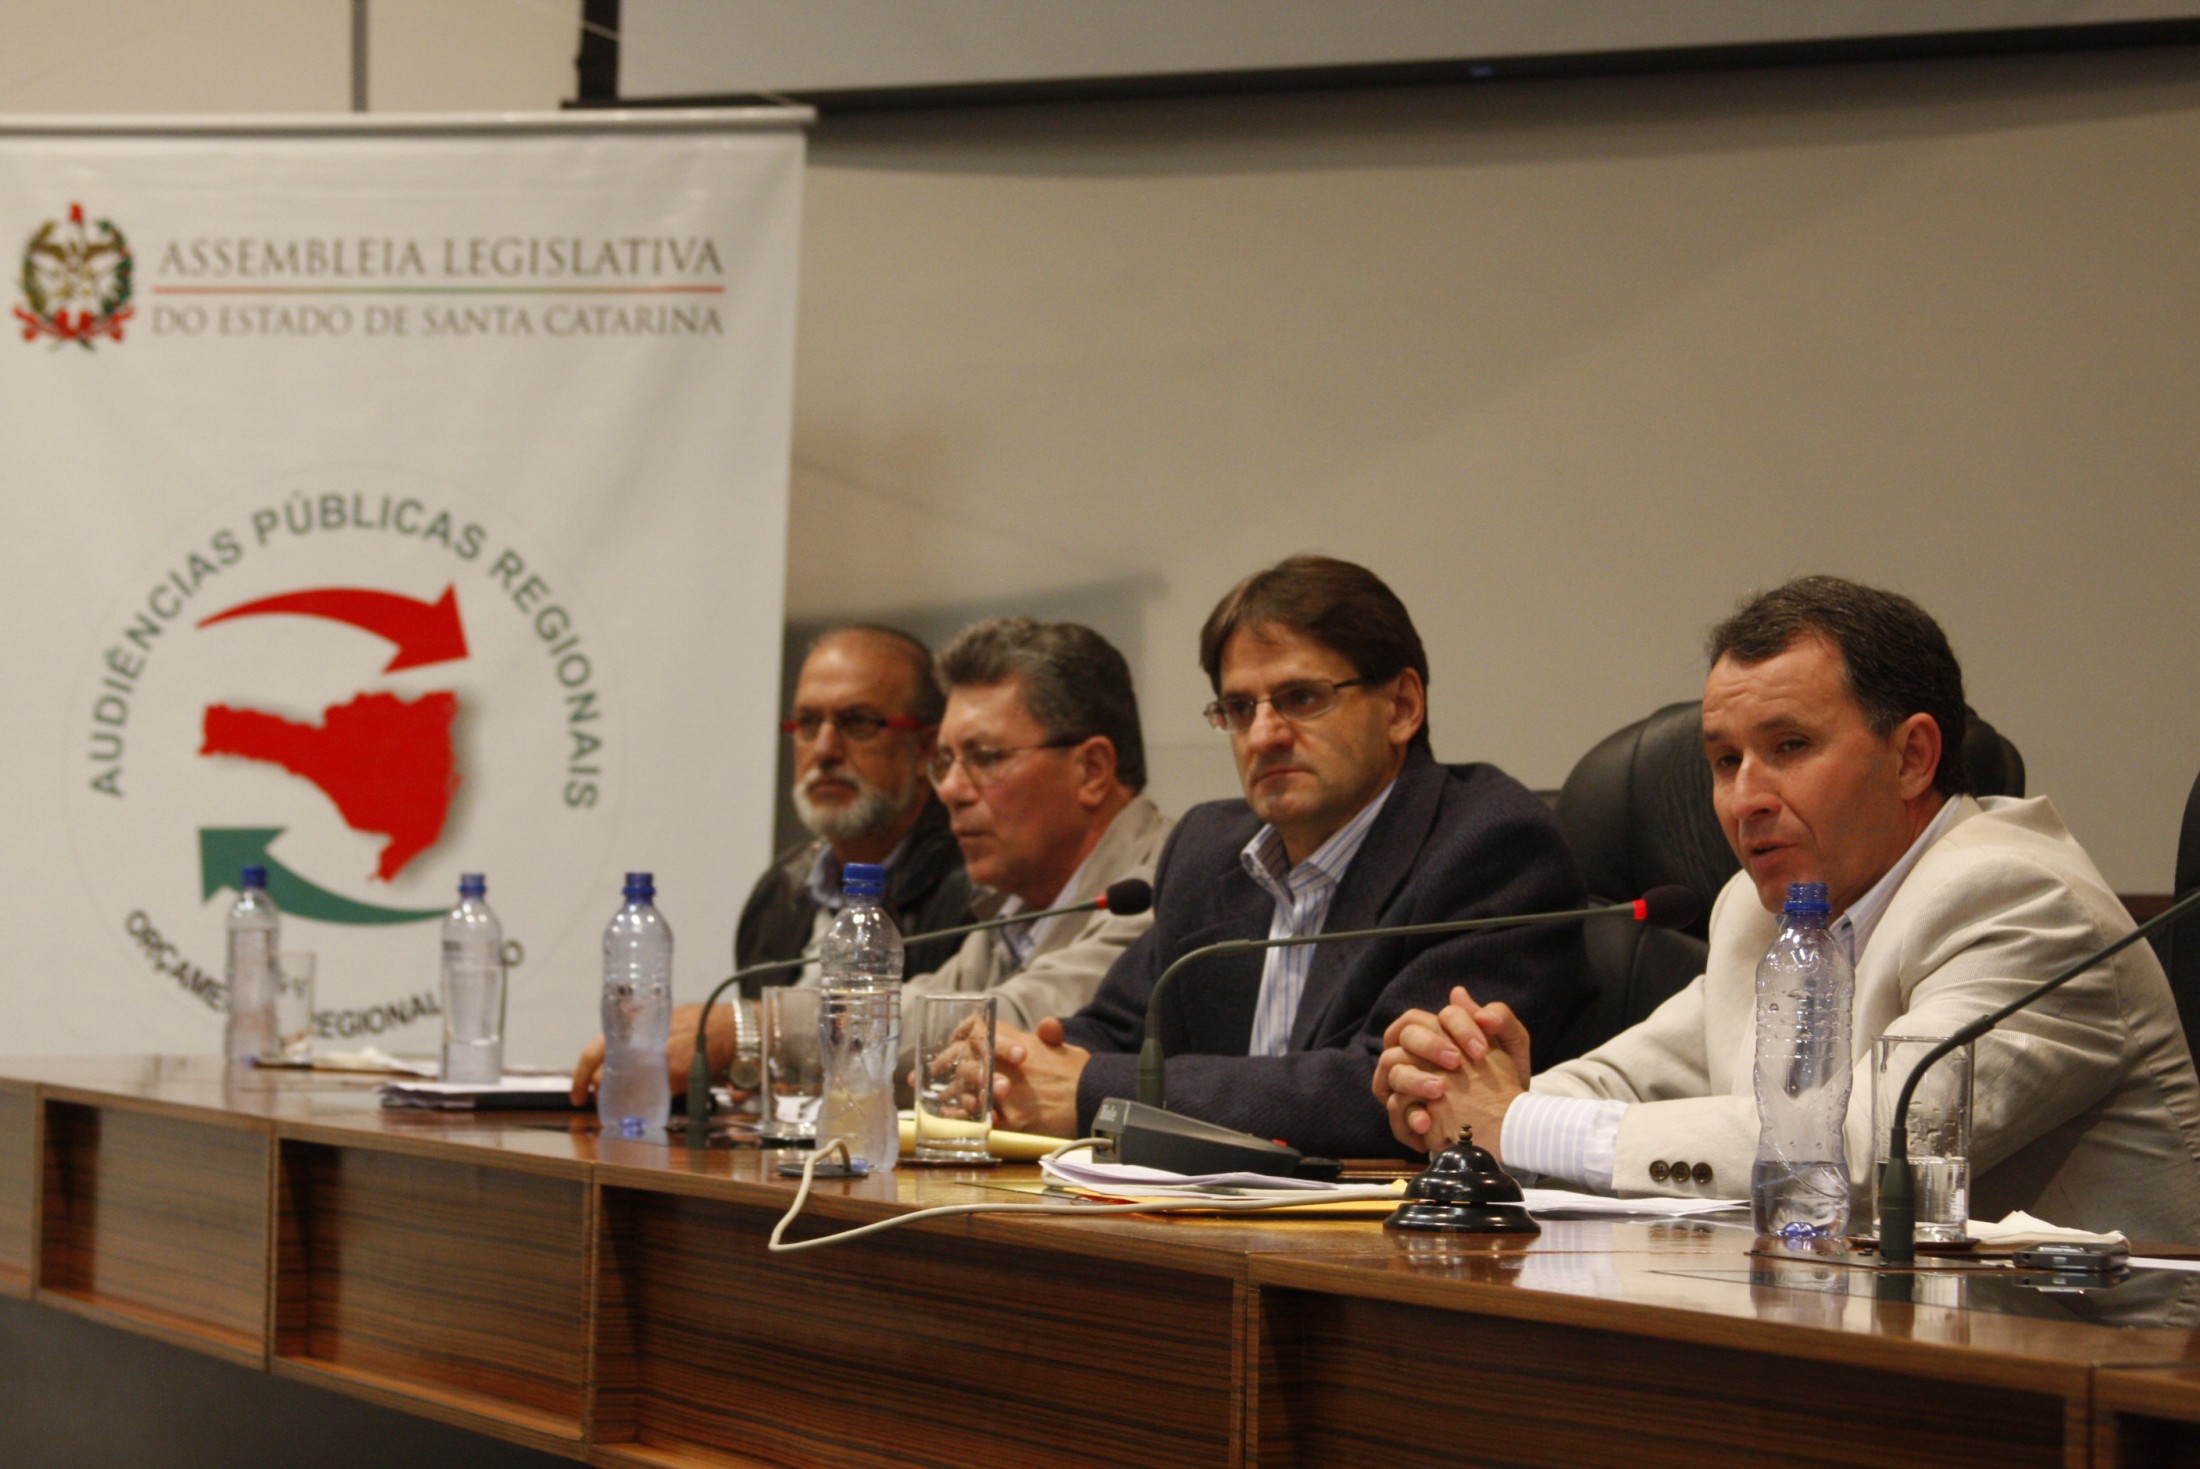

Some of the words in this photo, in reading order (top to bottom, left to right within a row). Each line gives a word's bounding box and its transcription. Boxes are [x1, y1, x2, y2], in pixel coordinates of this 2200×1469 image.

[157, 237, 427, 277] ASSEMBLEIA
[443, 236, 724, 277] LEGISLATIVA
[151, 303, 209, 337] DO
[218, 303, 354, 337] ESTADO
[364, 303, 410, 337] DE
[421, 304, 534, 337] SANTA
[542, 303, 724, 337] CATARINA
[88, 529, 246, 800] AUDIÊNCIAS
[251, 490, 488, 562] PÚBLICAS
[488, 549, 603, 811] REGIONAIS
[124, 909, 233, 1015] ORÇAME
